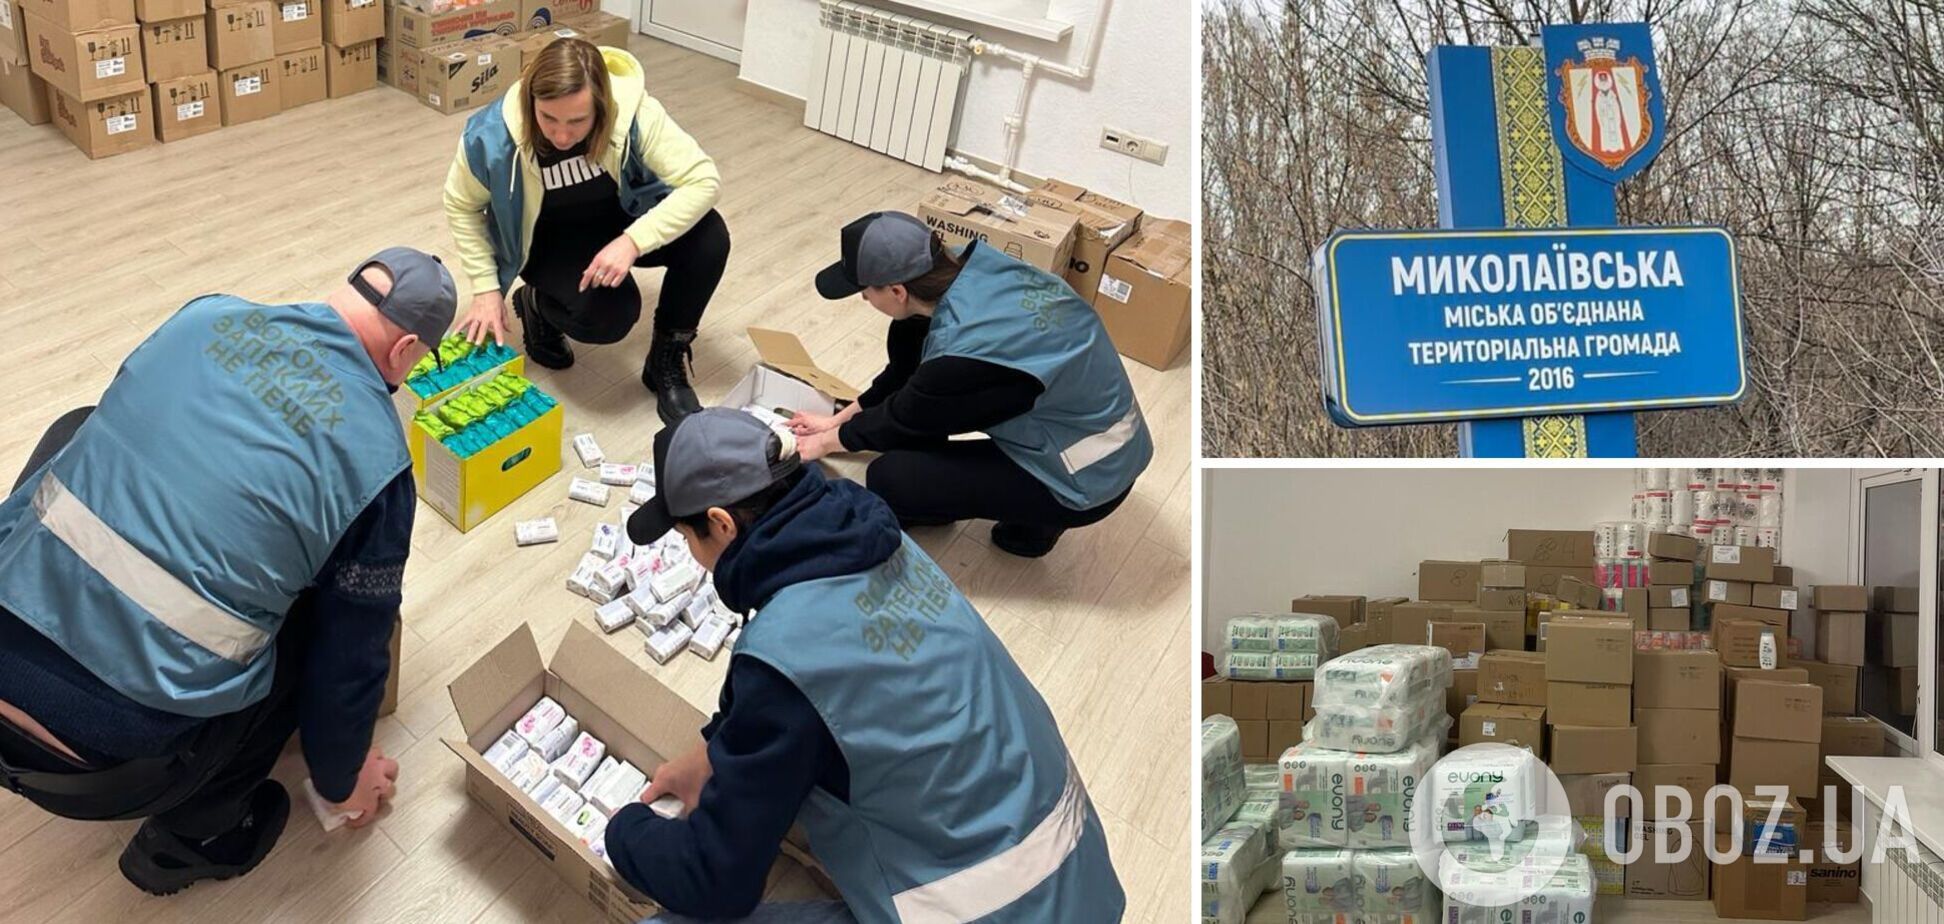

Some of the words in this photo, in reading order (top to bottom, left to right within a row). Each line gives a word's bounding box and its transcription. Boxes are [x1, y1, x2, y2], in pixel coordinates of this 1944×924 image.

[470, 64, 499, 94] Sila
[926, 214, 989, 244] WASHING
[1391, 243, 1684, 295] МИКОЛАЇВСЬКА
[1444, 303, 1526, 328] МІСЬКА
[1530, 299, 1644, 326] ОБ'ЄДНАНА
[243, 310, 345, 403] ВОГОНЬ
[1408, 336, 1581, 365] ТЕРИТОРІАЛЬНА
[1584, 331, 1681, 357] ГРОМАДА
[205, 339, 246, 374] НЕ
[243, 370, 317, 438] ПЕЧЕ
[212, 314, 345, 431] ЗАПЕКЛИХ
[1528, 367, 1575, 391] 2016
[1447, 770, 1504, 783] evony
[1331, 773, 1344, 831] evony
[1402, 775, 1415, 832] evony
[1810, 866, 1857, 879] sanino
